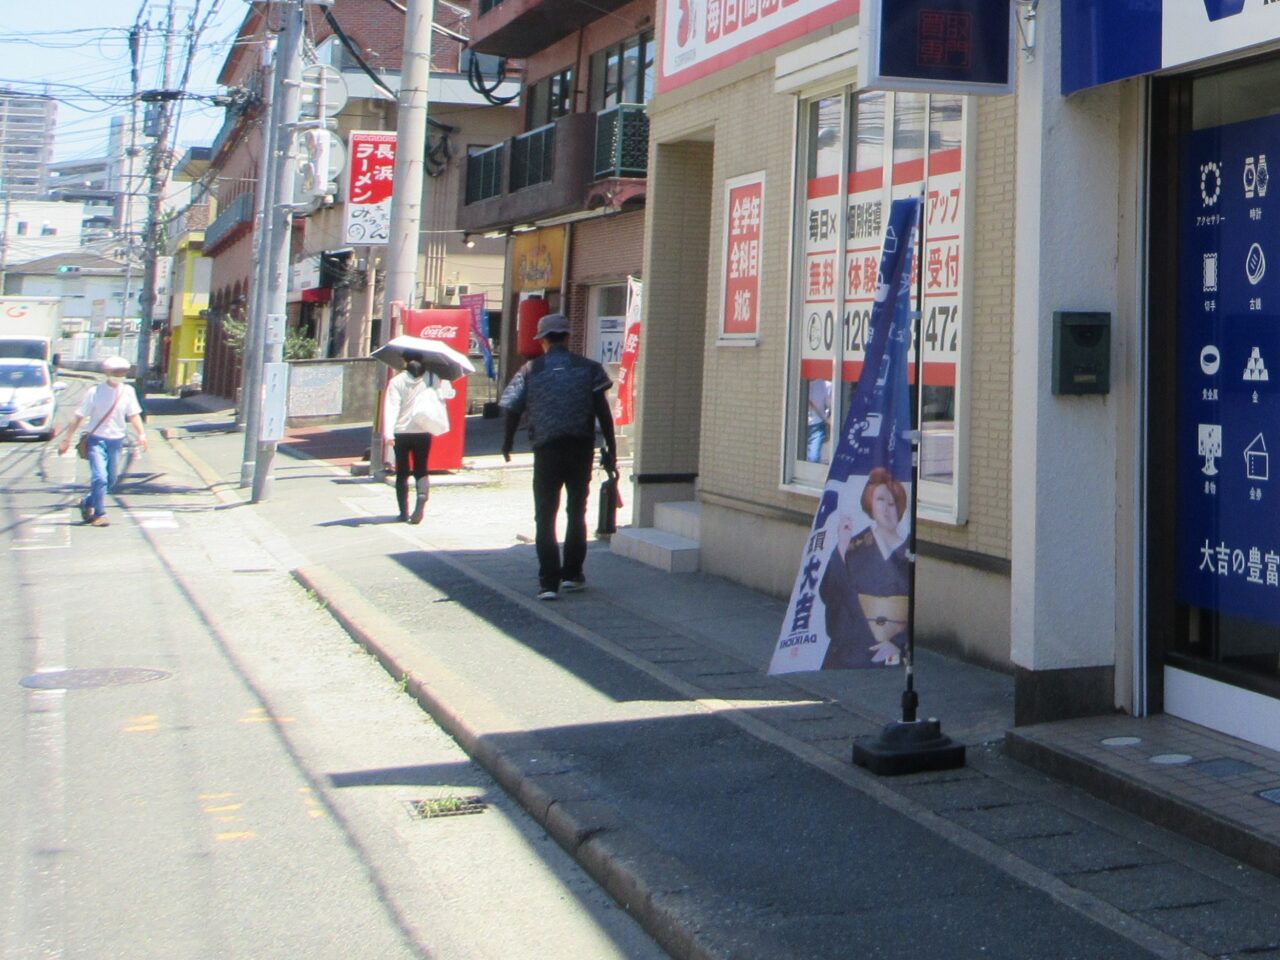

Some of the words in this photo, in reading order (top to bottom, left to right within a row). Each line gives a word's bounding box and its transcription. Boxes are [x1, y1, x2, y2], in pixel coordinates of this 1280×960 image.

[353, 143, 375, 203] ラーメン
[374, 143, 394, 181] 長浜
[732, 195, 760, 236] 全学年
[1249, 207, 1263, 222] 時計
[730, 240, 758, 278] 全科目
[809, 258, 834, 297] 無料
[847, 256, 877, 295] 体験
[927, 244, 960, 289] 受付
[733, 288, 751, 321] 対応
[420, 325, 460, 339] Coca-Cola
[1251, 390, 1260, 404] 金
